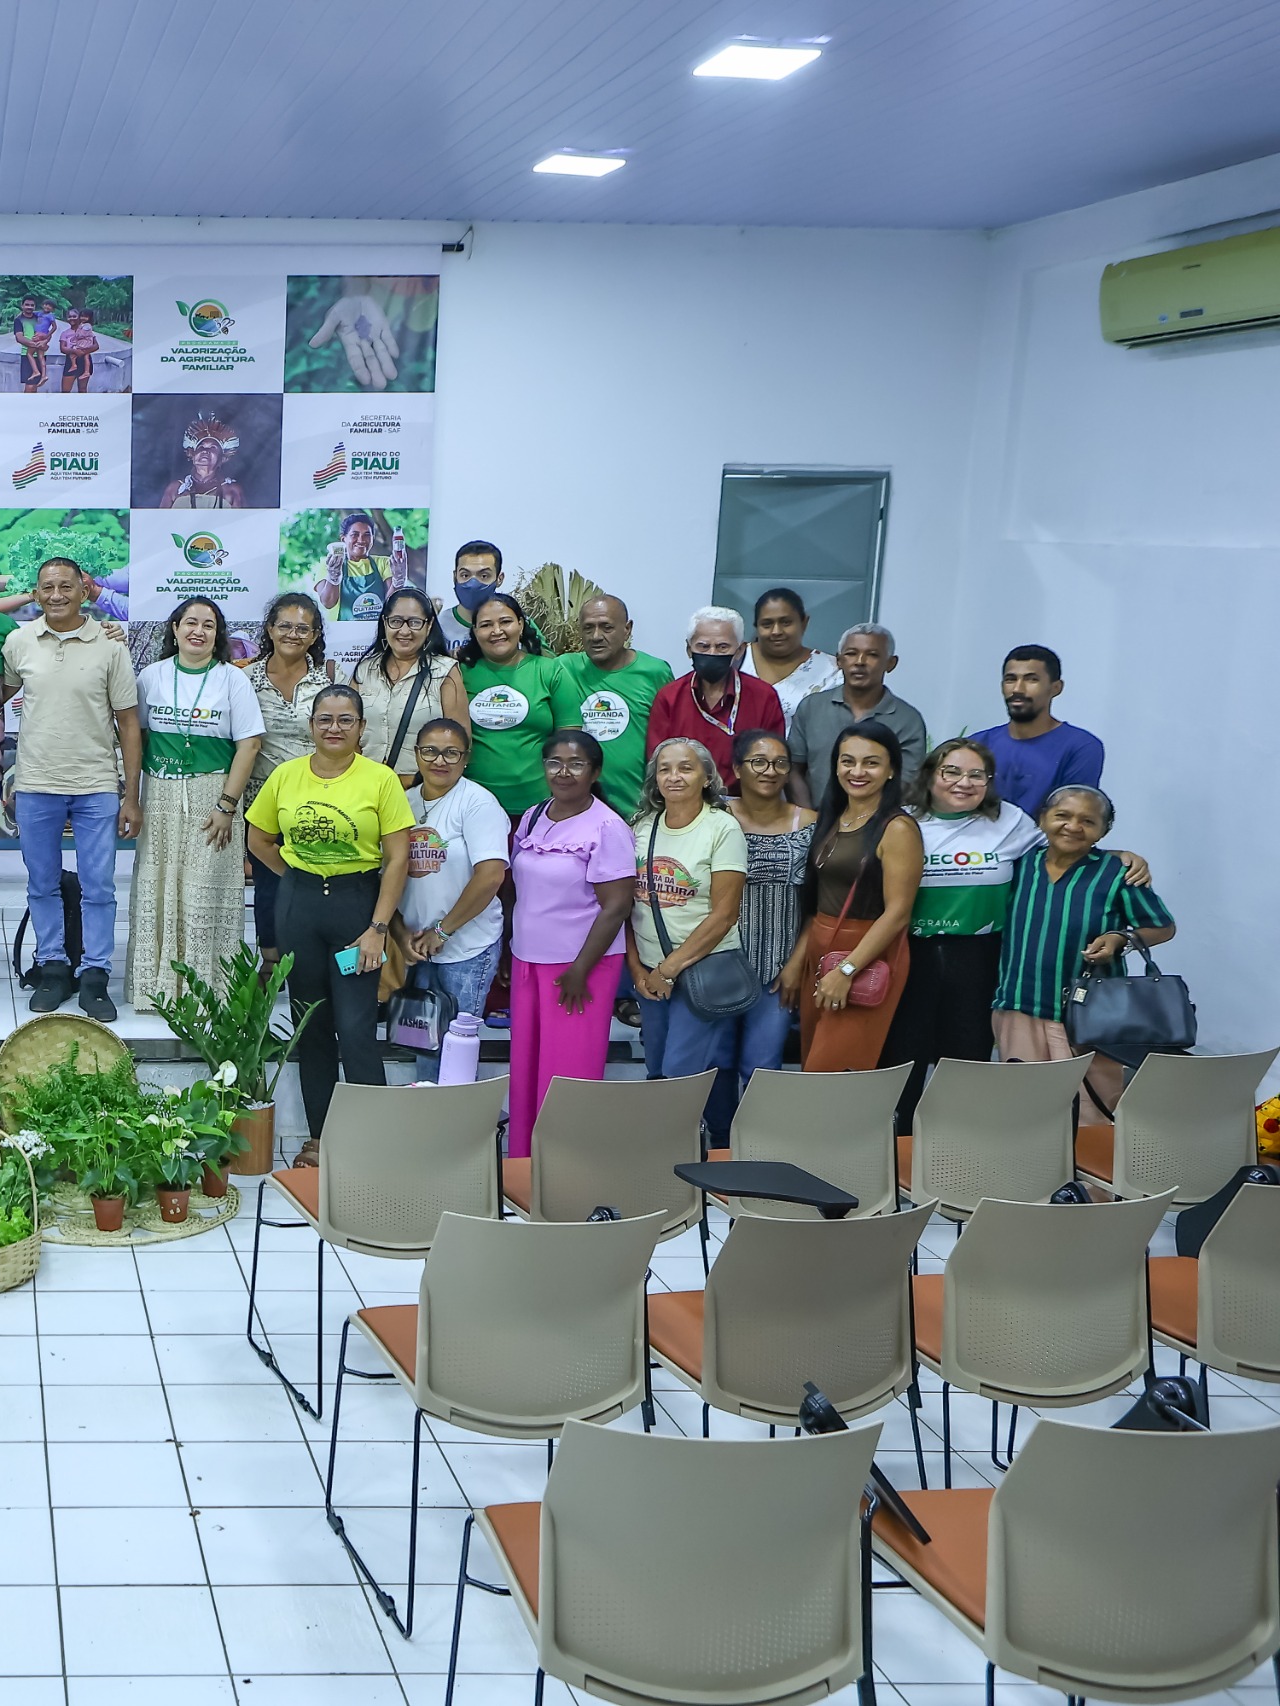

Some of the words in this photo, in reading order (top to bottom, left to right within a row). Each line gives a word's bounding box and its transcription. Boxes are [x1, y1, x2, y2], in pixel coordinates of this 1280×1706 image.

[171, 347, 247, 355] VALORIZAÇÃO
[166, 577, 241, 585] VALORIZAÇÃO
[582, 711, 624, 719] QUITANDA
[664, 876, 675, 885] DA
